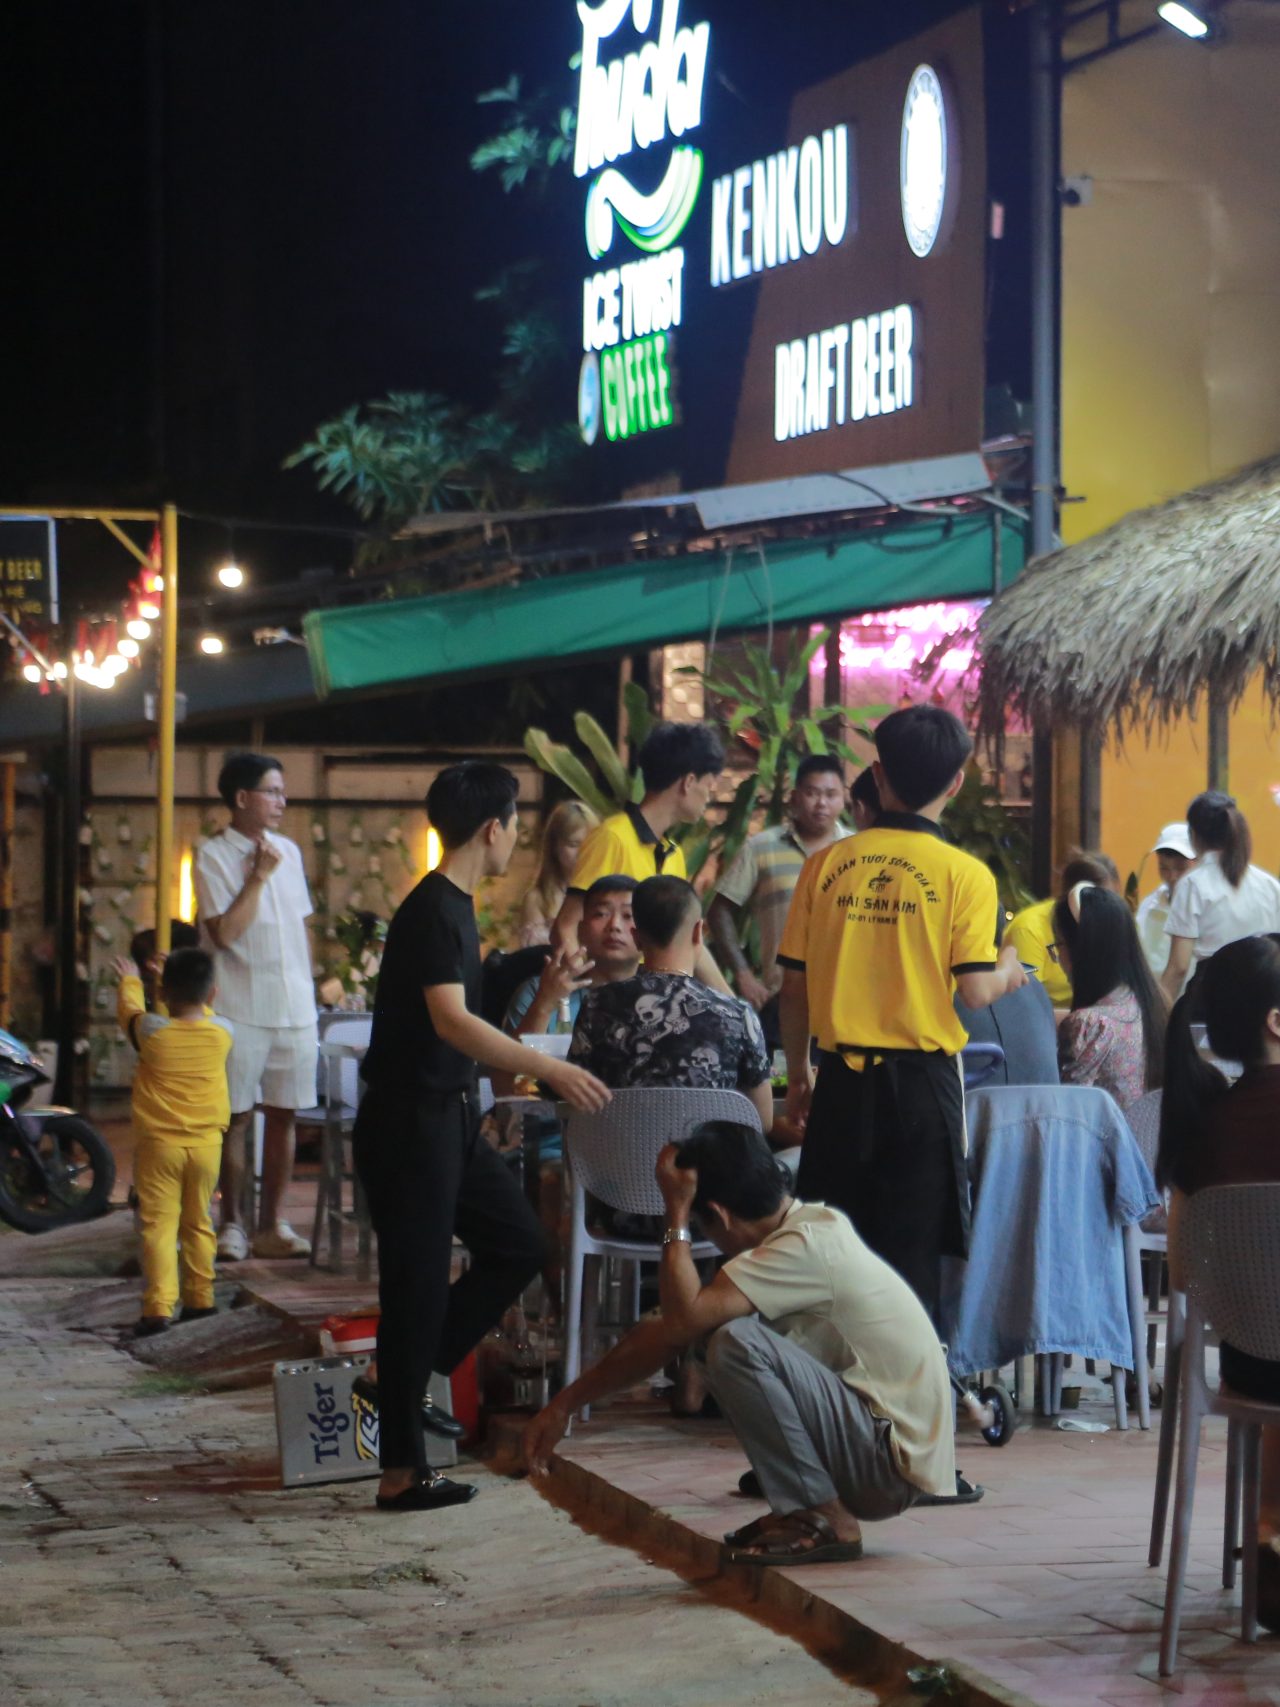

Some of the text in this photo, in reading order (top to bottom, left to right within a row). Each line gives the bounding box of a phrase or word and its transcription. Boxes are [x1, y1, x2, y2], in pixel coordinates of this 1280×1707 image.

[711, 123, 848, 288] KENKOU
[583, 269, 620, 352] ICE
[601, 331, 673, 441] COFFEE
[774, 303, 912, 442] DRAFT BEER
[892, 901, 917, 915] KIM
[307, 1382, 350, 1465] Tiger
